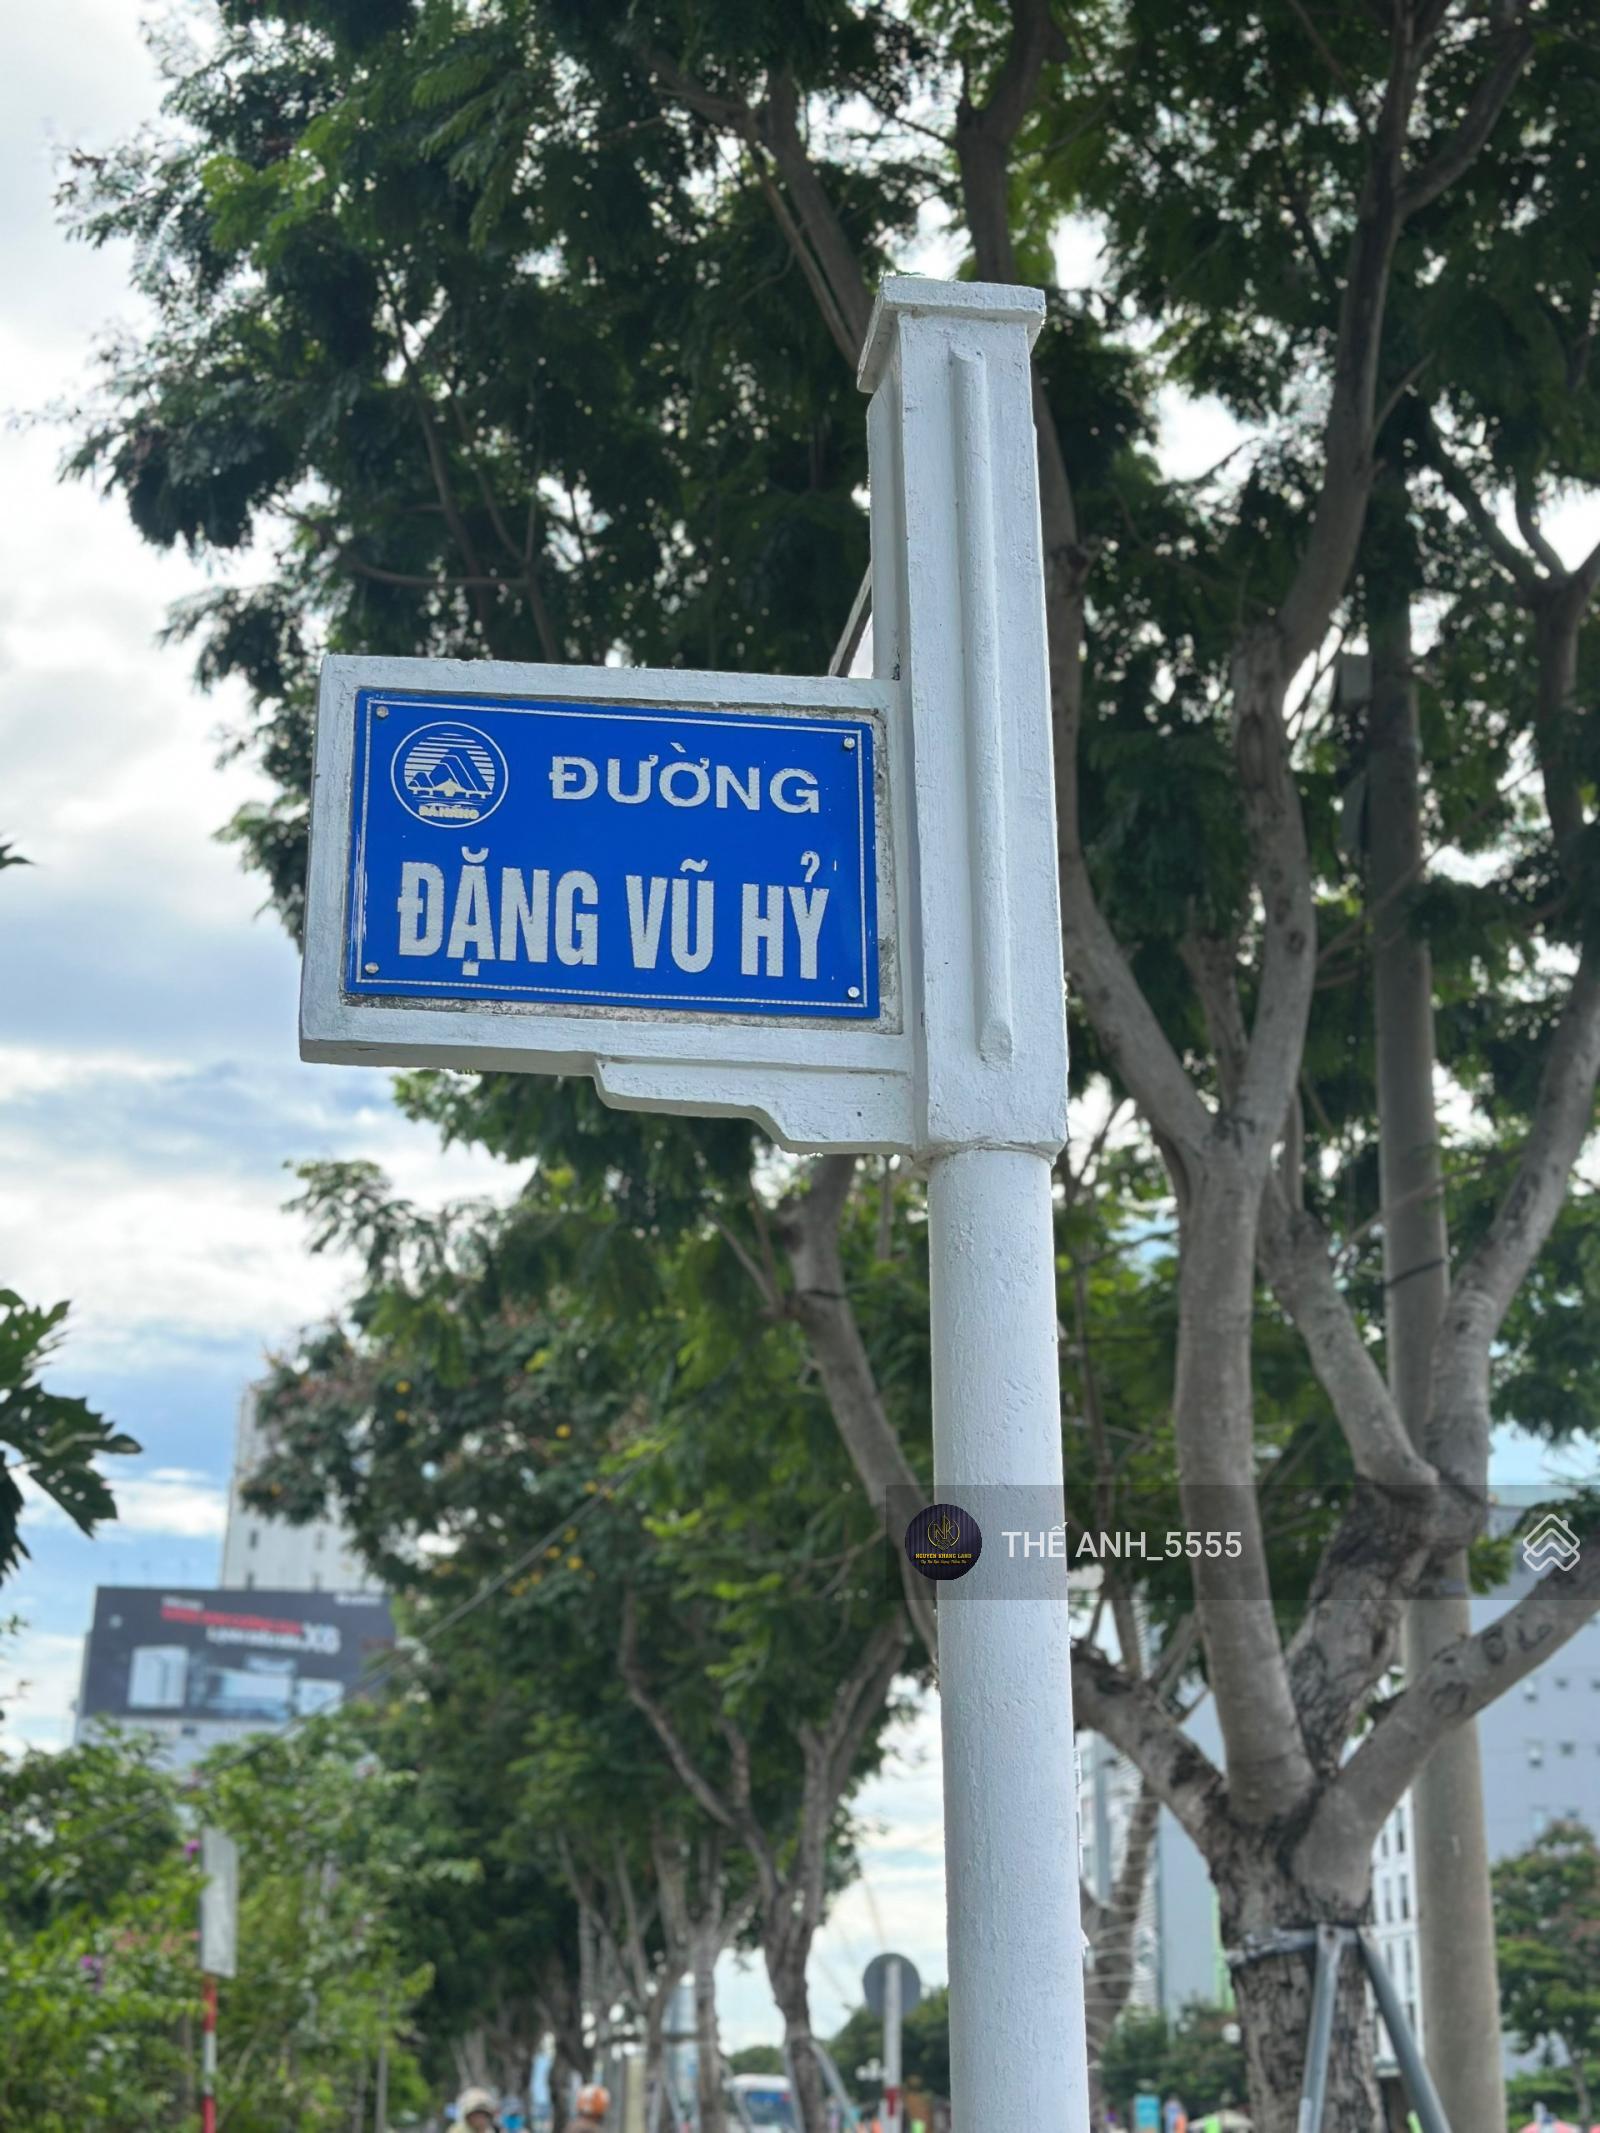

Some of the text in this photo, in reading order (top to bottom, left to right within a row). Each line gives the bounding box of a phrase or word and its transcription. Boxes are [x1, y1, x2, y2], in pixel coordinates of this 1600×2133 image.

[549, 742, 820, 814] ĐƯỜNG
[397, 846, 830, 980] ĐẶNG VŨ HỶ
